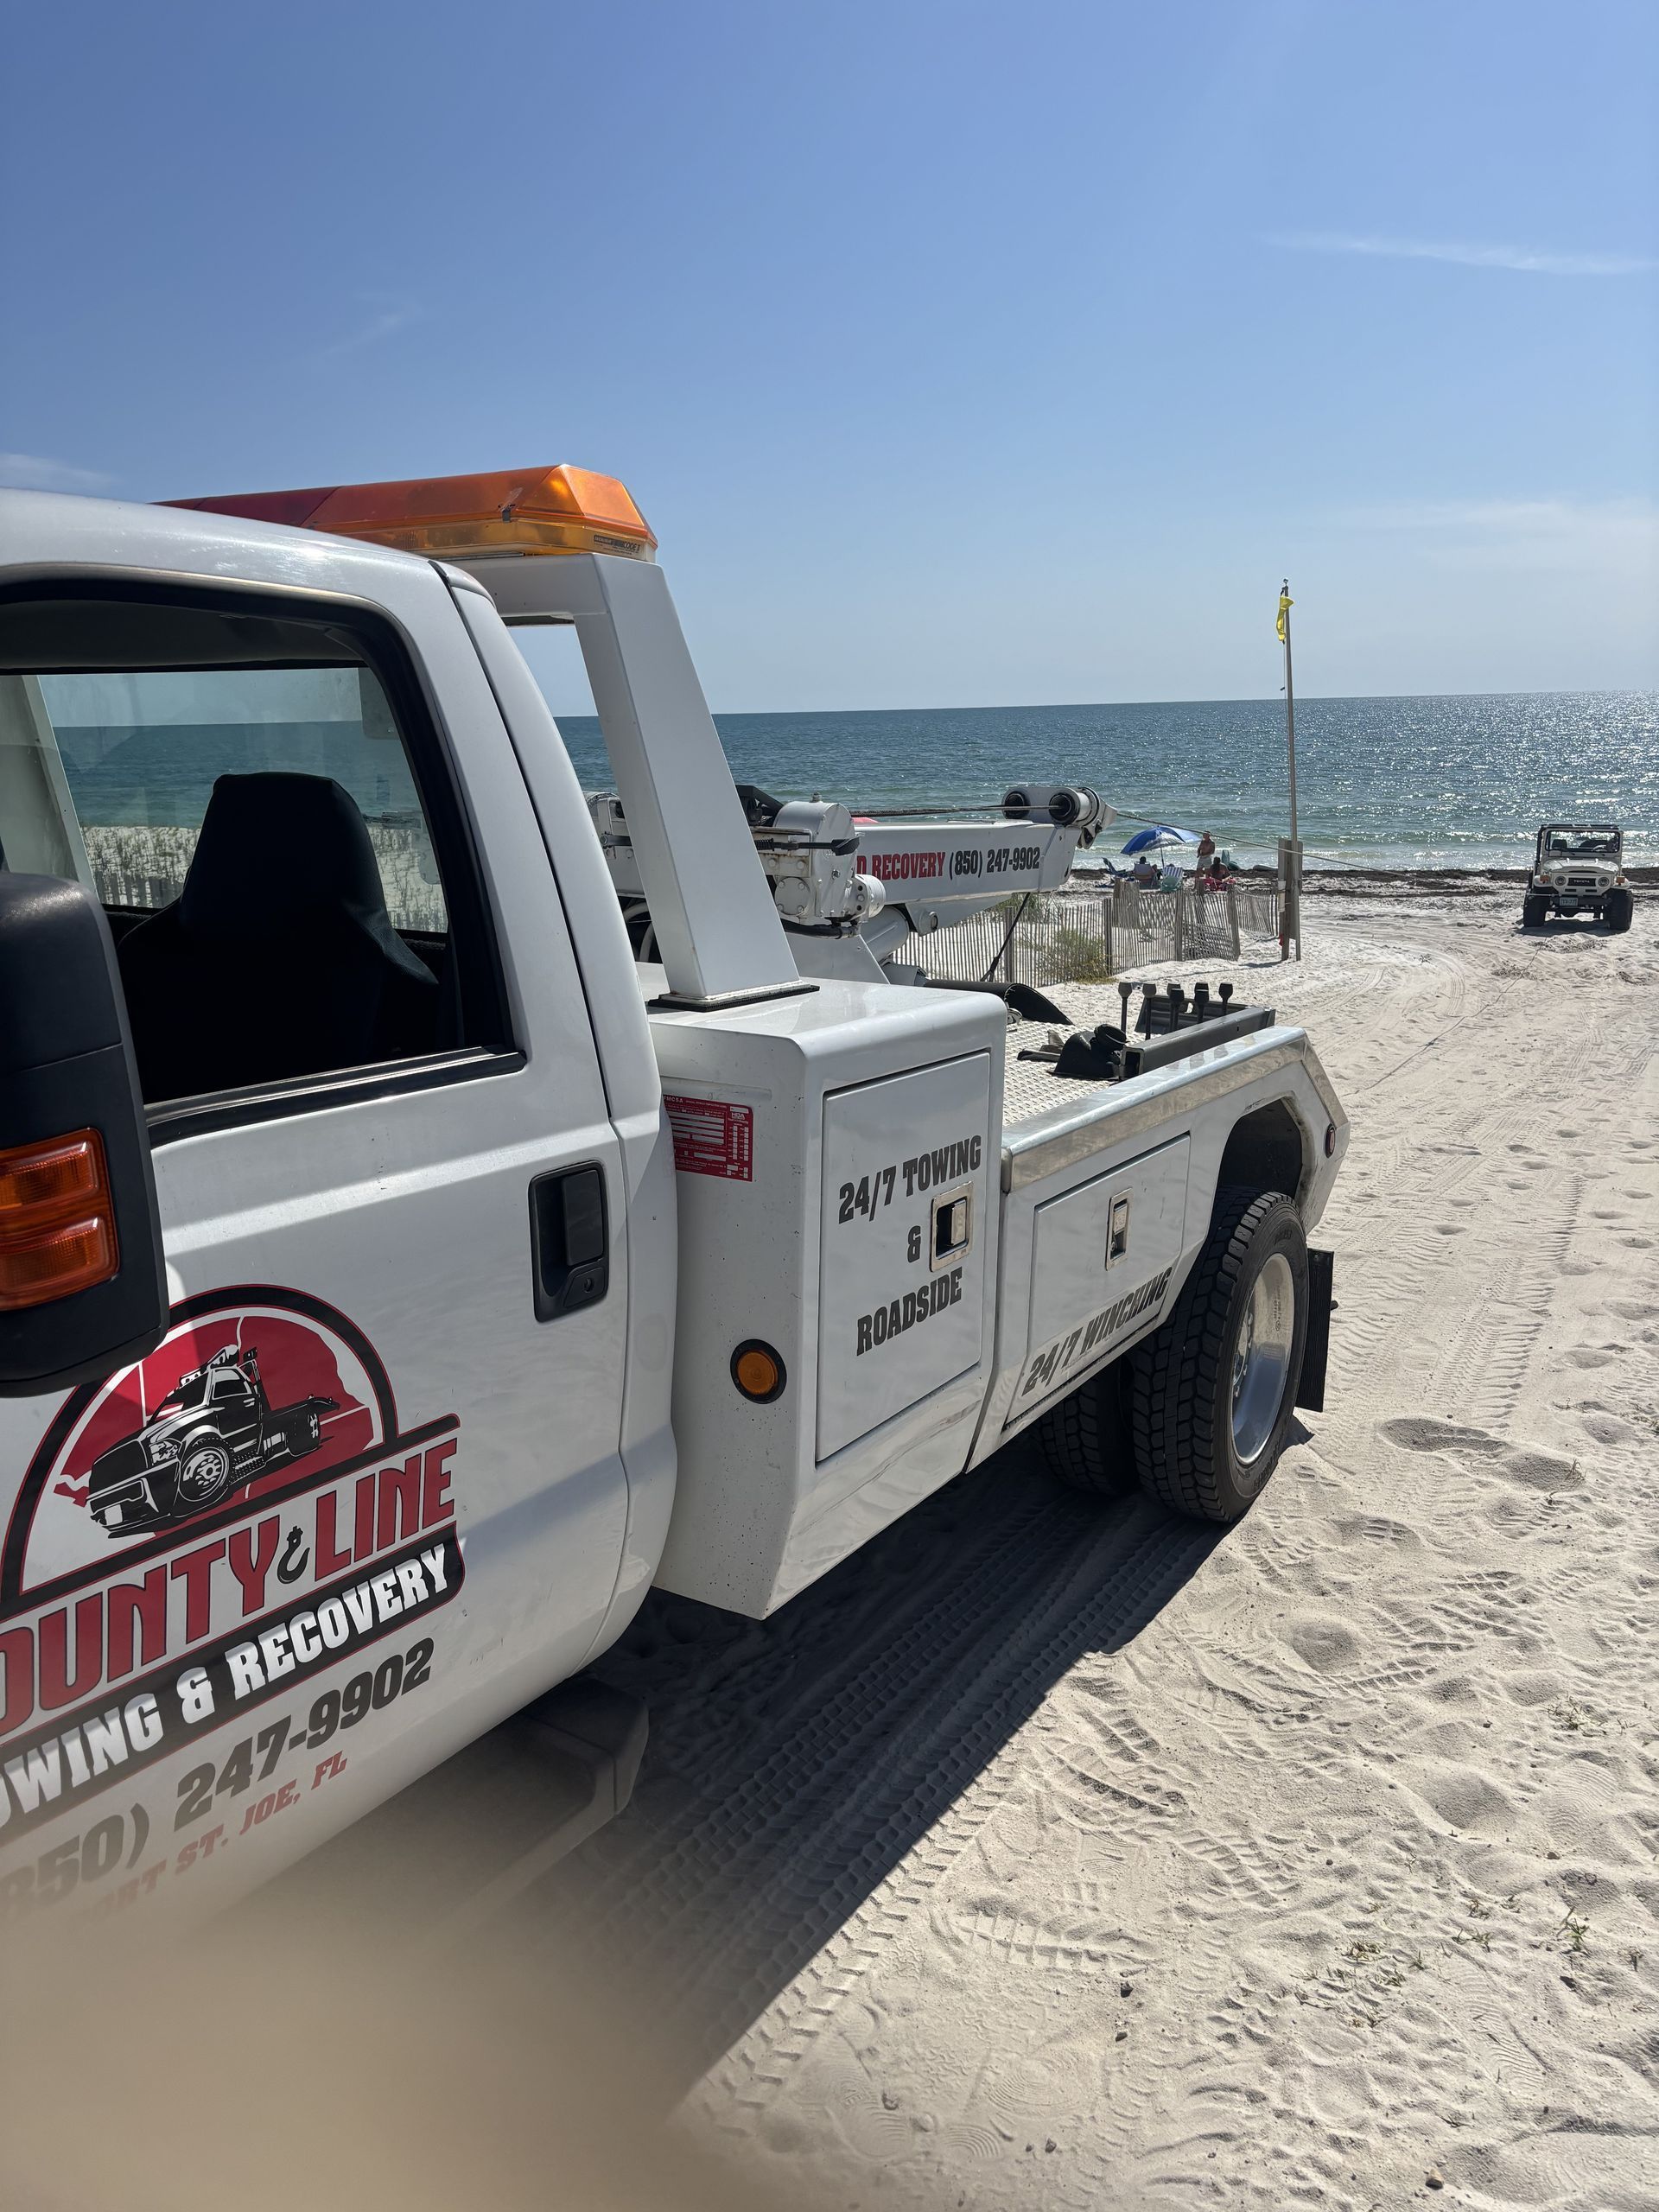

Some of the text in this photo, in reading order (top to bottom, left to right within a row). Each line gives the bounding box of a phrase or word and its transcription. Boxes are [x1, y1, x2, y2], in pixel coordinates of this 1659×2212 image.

[872, 852, 945, 880] RECOVERY
[949, 850, 982, 880] (850)
[986, 847, 1040, 874] 247-9902
[839, 1135, 982, 1224] 24/7 TOWING
[907, 1225, 921, 1263] &
[856, 1266, 963, 1357] ROADSIDE
[1022, 1266, 1173, 1396] 24/7 WINCHING
[315, 1438, 458, 1582] LINE
[0, 1543, 448, 1829] WING & RECOVERY
[174, 1637, 435, 1833] 247-9902
[175, 1824, 229, 1875] ST.
[239, 1778, 301, 1835] JOE,
[311, 1750, 347, 1791] FL
